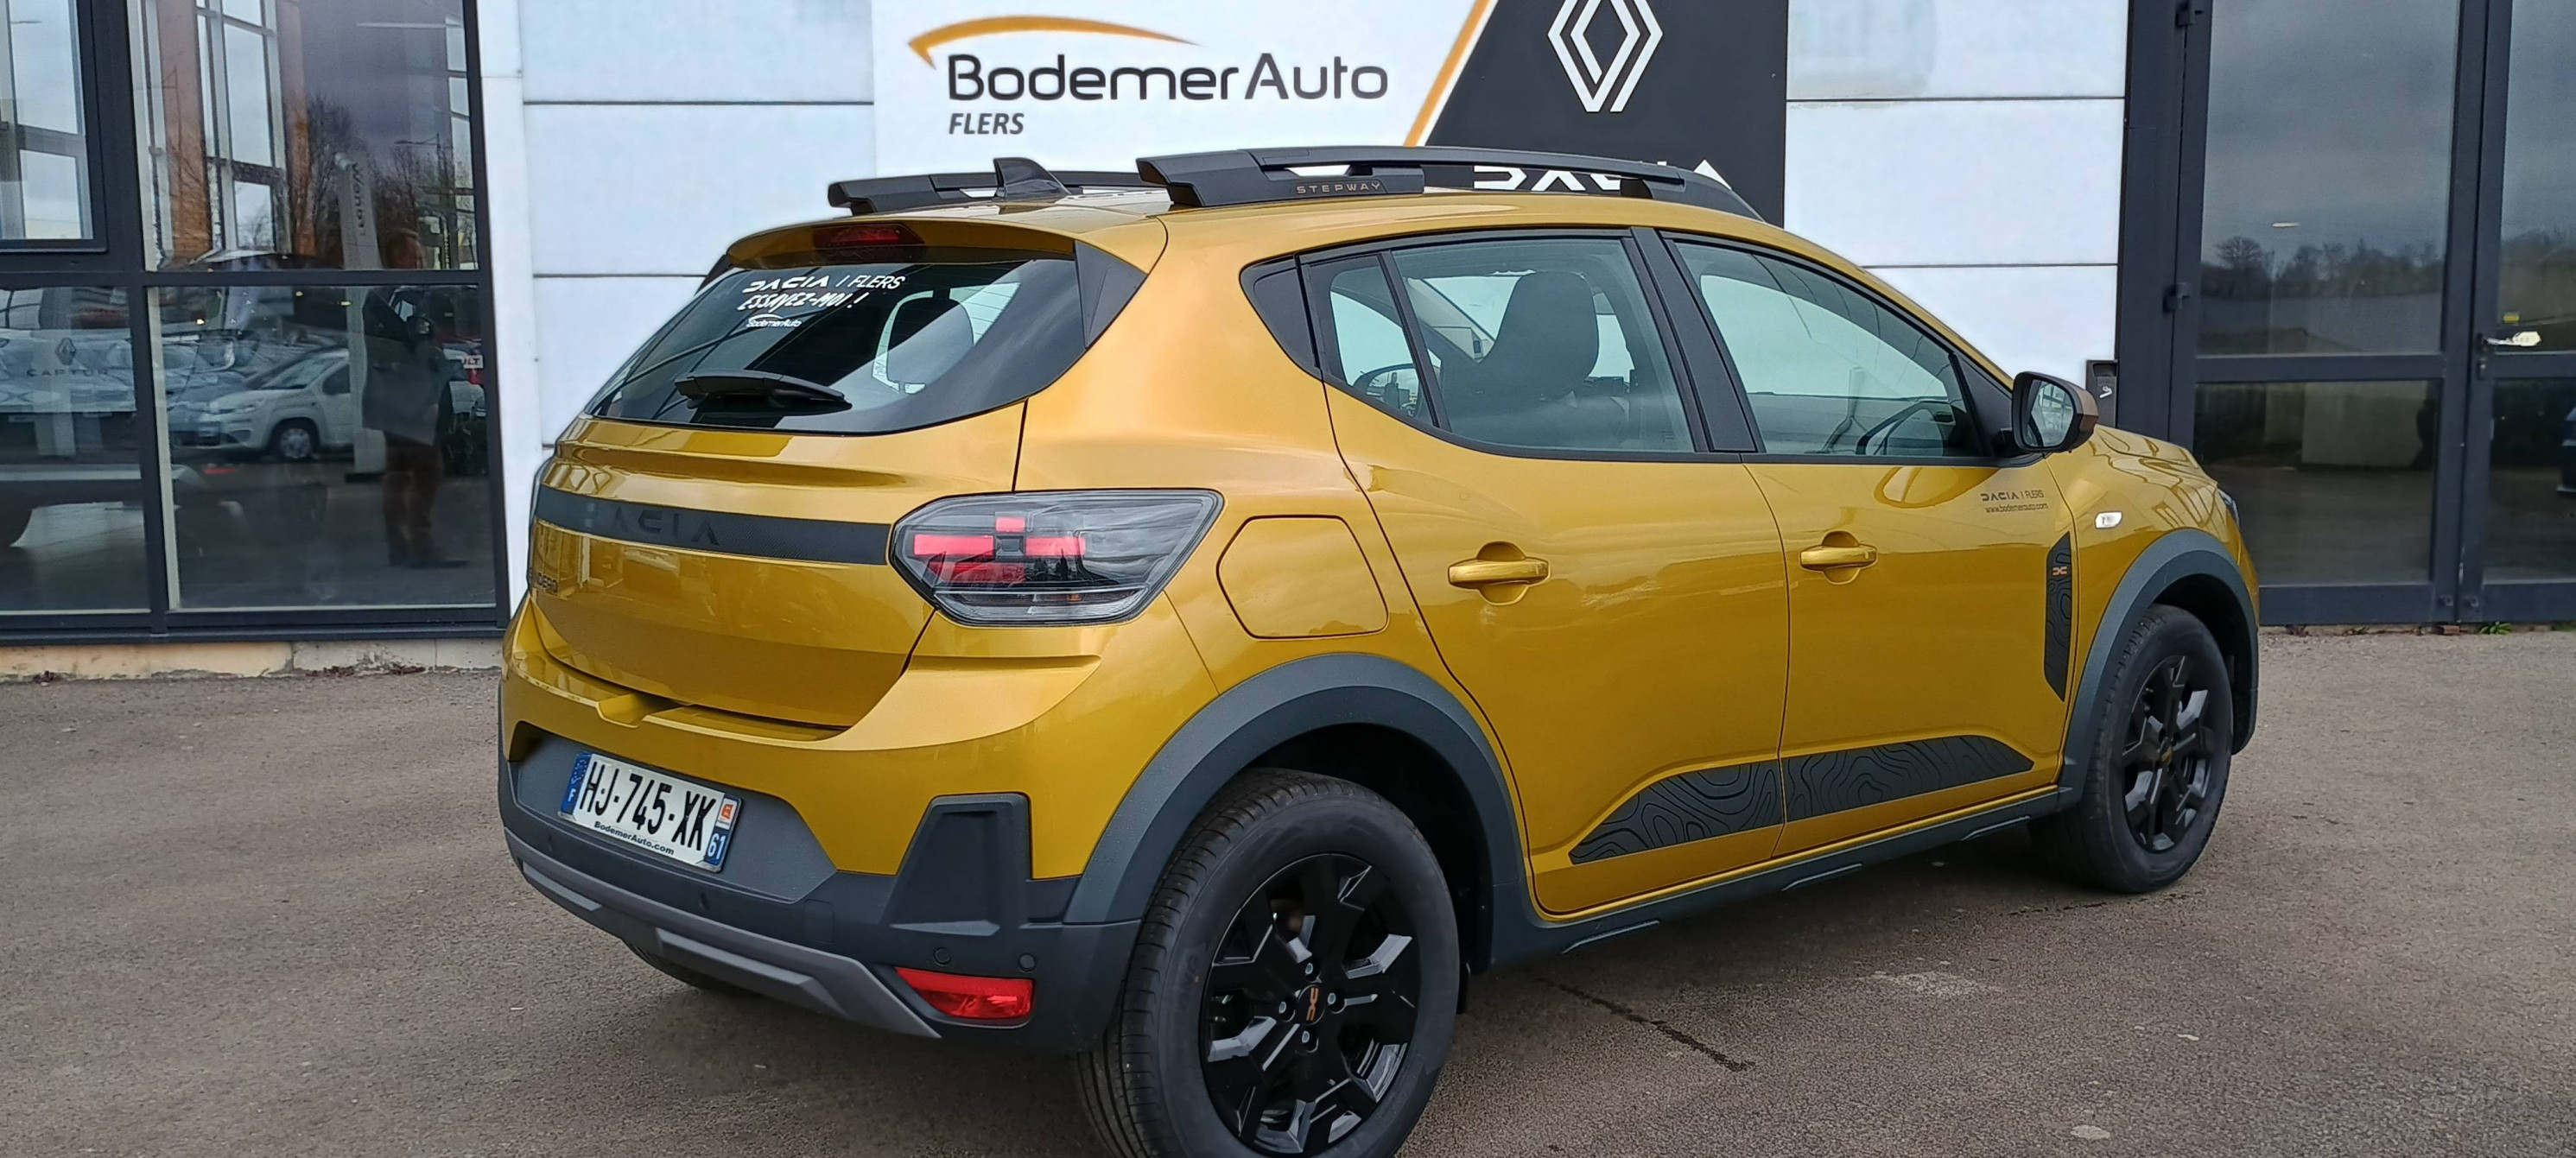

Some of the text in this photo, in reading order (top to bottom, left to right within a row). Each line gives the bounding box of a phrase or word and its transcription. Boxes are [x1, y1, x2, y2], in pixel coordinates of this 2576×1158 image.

[949, 112, 1025, 136] FLERS
[1297, 183, 1382, 194] STEPWAY
[743, 275, 905, 294] DACIA FLERS
[1980, 490, 2044, 502] DACIA FLERS
[567, 788, 576, 802] F
[579, 761, 717, 851] HJ-745-XK
[593, 820, 675, 856] BodemerAuto.com
[707, 832, 725, 860] 61
